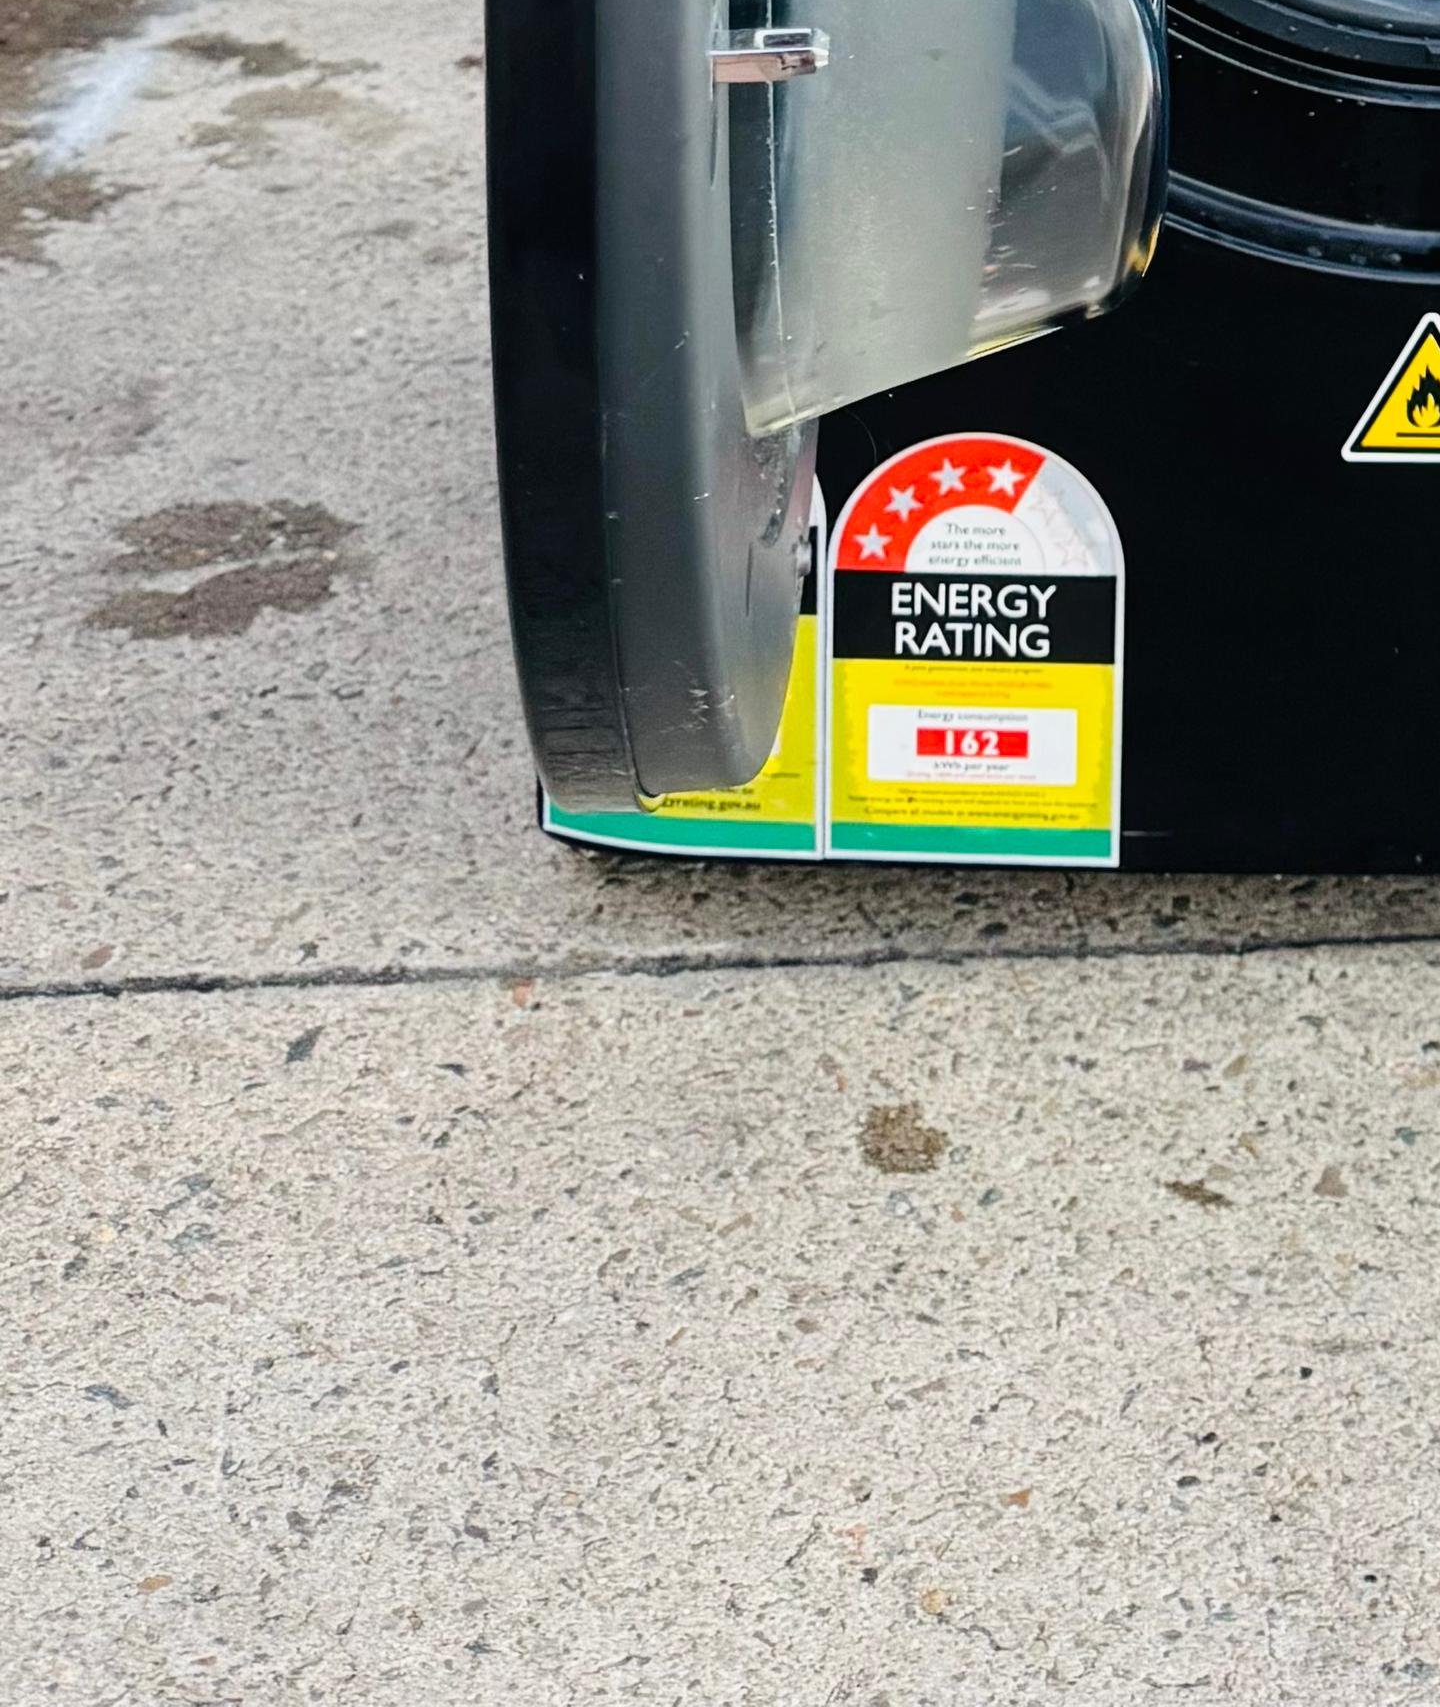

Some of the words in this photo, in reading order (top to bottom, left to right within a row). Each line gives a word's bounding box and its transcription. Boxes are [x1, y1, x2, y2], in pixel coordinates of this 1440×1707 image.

[946, 522, 969, 535] The
[971, 526, 1007, 536] more
[930, 540, 961, 551] stars
[963, 539, 983, 551] the
[985, 542, 1020, 552] more
[928, 556, 970, 568] energy
[890, 581, 1058, 619] ENERGY
[895, 620, 1051, 659] RATING
[944, 729, 1000, 756] 162
